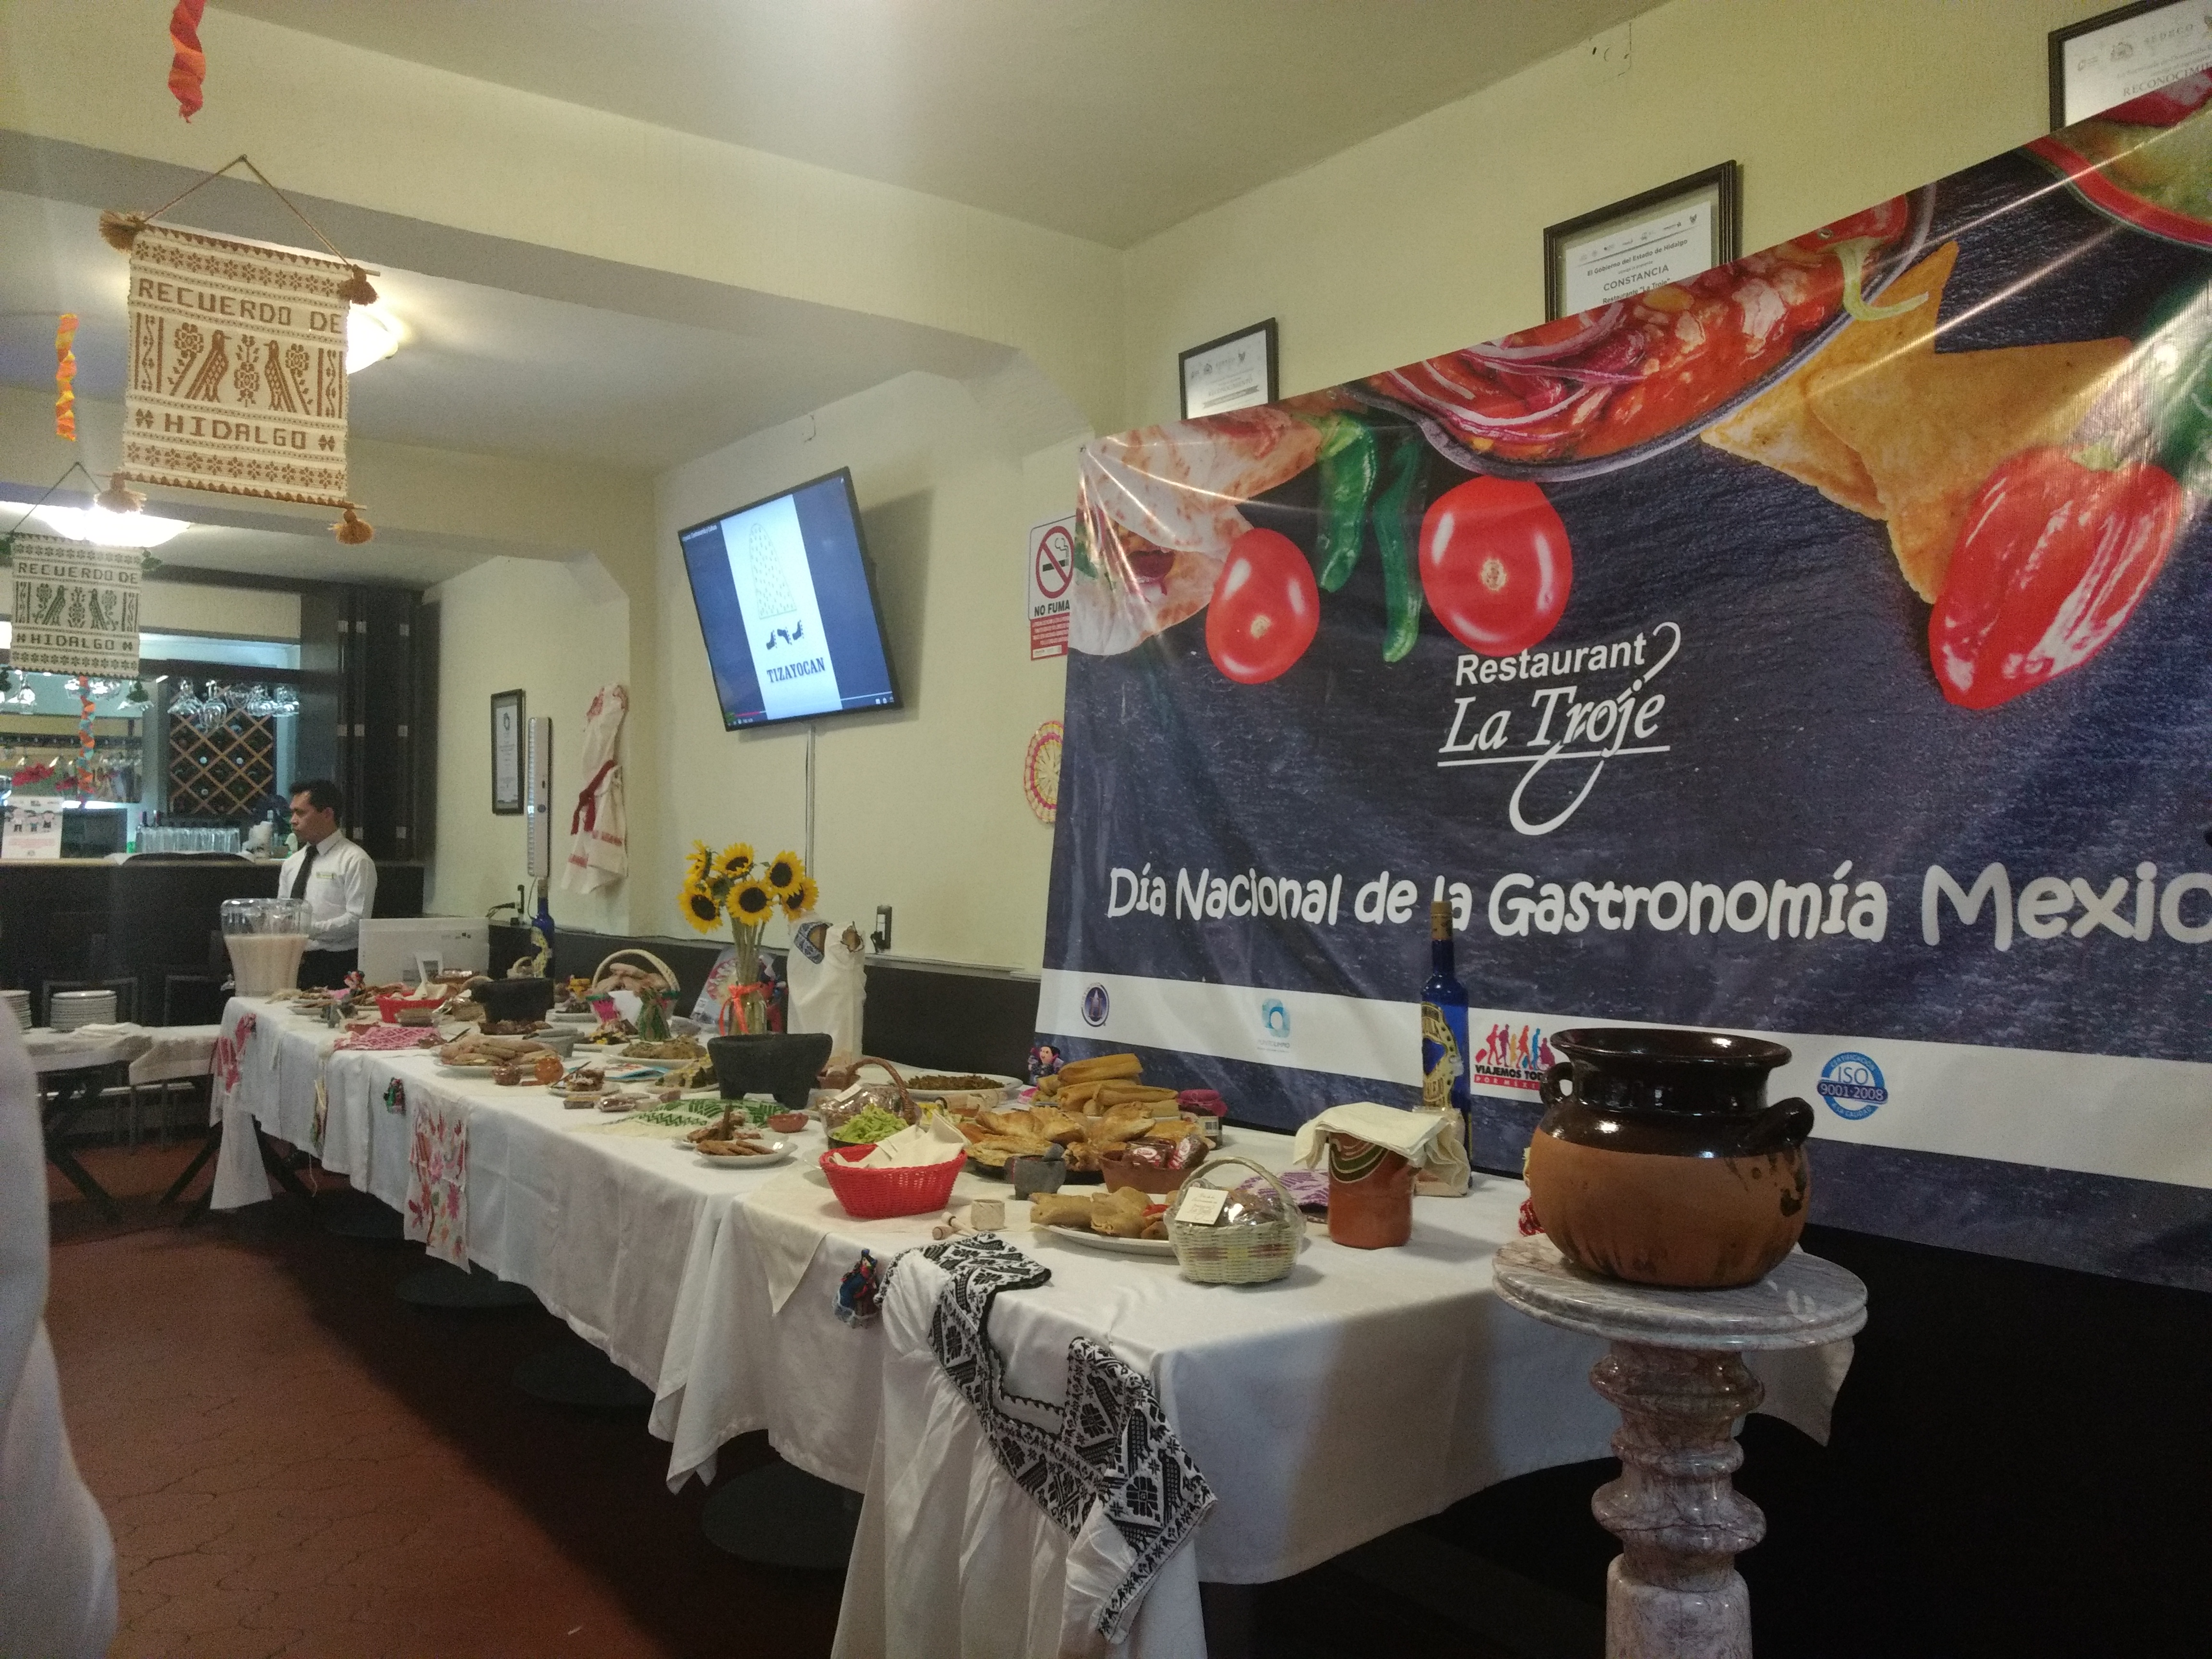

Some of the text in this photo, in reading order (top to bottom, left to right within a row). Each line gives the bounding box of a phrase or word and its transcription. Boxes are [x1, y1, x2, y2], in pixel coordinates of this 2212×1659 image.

[1594, 262, 1621, 275] Gobierno
[1622, 257, 1631, 265] del
[1633, 250, 1653, 261] Estado
[1663, 239, 1688, 252] Hidalgo
[1603, 264, 1670, 291] CONSTANCIA
[138, 277, 343, 334] RECUERDO DE
[164, 412, 307, 450] HIDALGO
[18, 562, 139, 584] RECUERDO DE
[1034, 606, 1046, 617] NO
[31, 634, 115, 650] HIDALGO
[766, 657, 826, 684] TIZAYOCAN
[1455, 632, 1647, 686] Restaurant
[1438, 696, 1512, 754] La
[1106, 862, 1167, 919] Día
[1175, 866, 1343, 926] Nacional
[1354, 870, 1419, 925] de
[1433, 875, 1473, 931] la
[1488, 859, 1888, 943] Gastronomía
[1475, 1064, 1522, 1079] VIAJEMOS
[1475, 1075, 1498, 1084] POR
[1837, 1066, 1869, 1085] ISO
